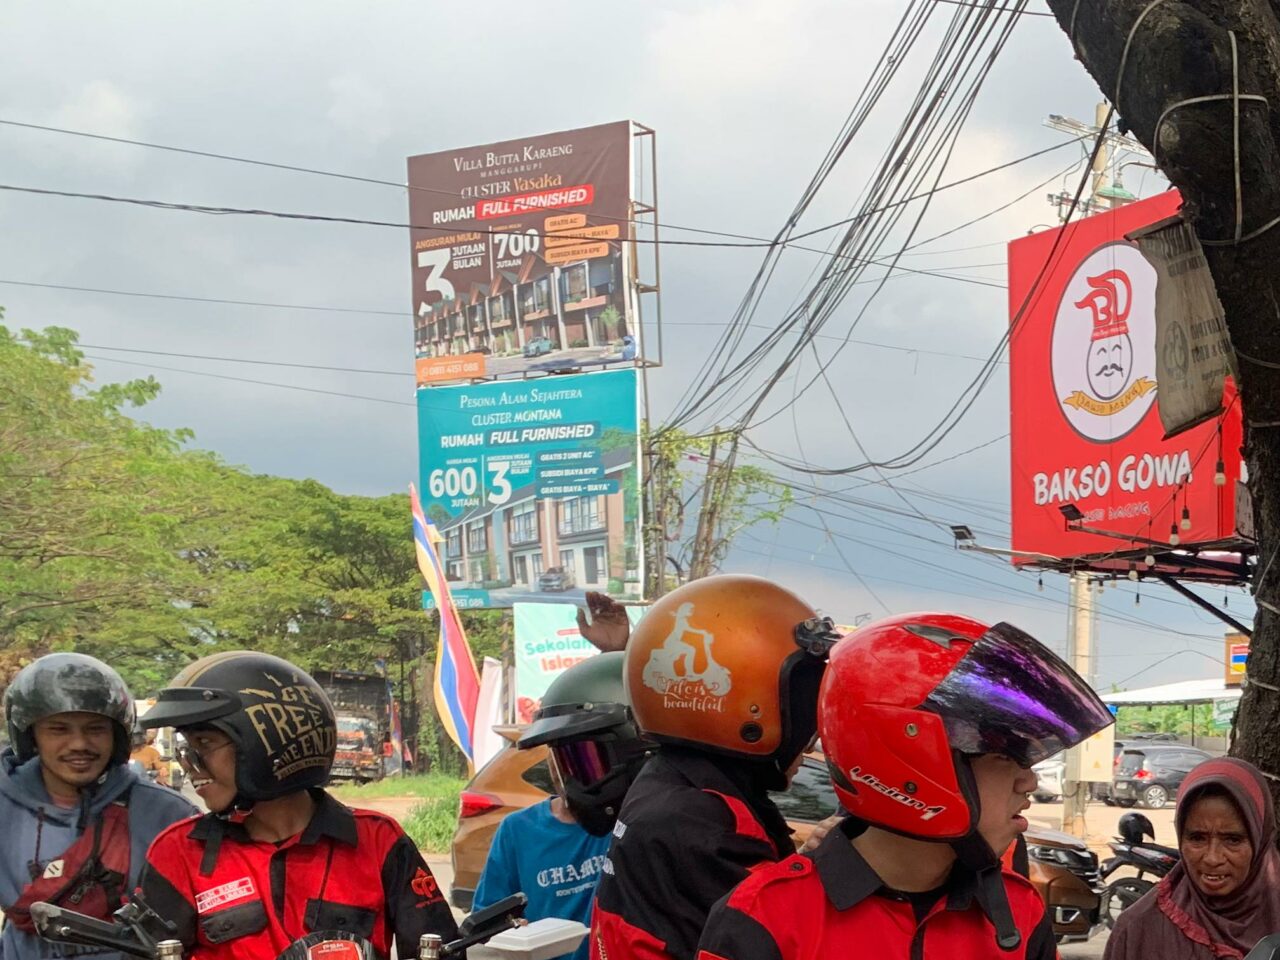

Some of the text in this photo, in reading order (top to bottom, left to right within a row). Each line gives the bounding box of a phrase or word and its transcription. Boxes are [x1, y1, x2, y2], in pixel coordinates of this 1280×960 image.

[486, 152, 520, 167] BUTTA
[523, 144, 573, 161] KARAENG
[514, 174, 562, 192] Vasaka
[433, 189, 587, 224] RUMAH FULL FURNISHED
[452, 243, 485, 256] JUTAAN
[494, 228, 539, 259] 700
[453, 257, 481, 270] BULAN
[417, 248, 455, 317] 3
[499, 392, 528, 405] ALAM
[530, 388, 583, 404] SEJAHTERA
[472, 409, 562, 426] CLUSTER MONTANA
[441, 424, 595, 448] RUMAH FULL FURNISHED
[429, 466, 477, 498] 600
[487, 461, 512, 505] 3
[1033, 450, 1193, 505] BAKSO GOWA
